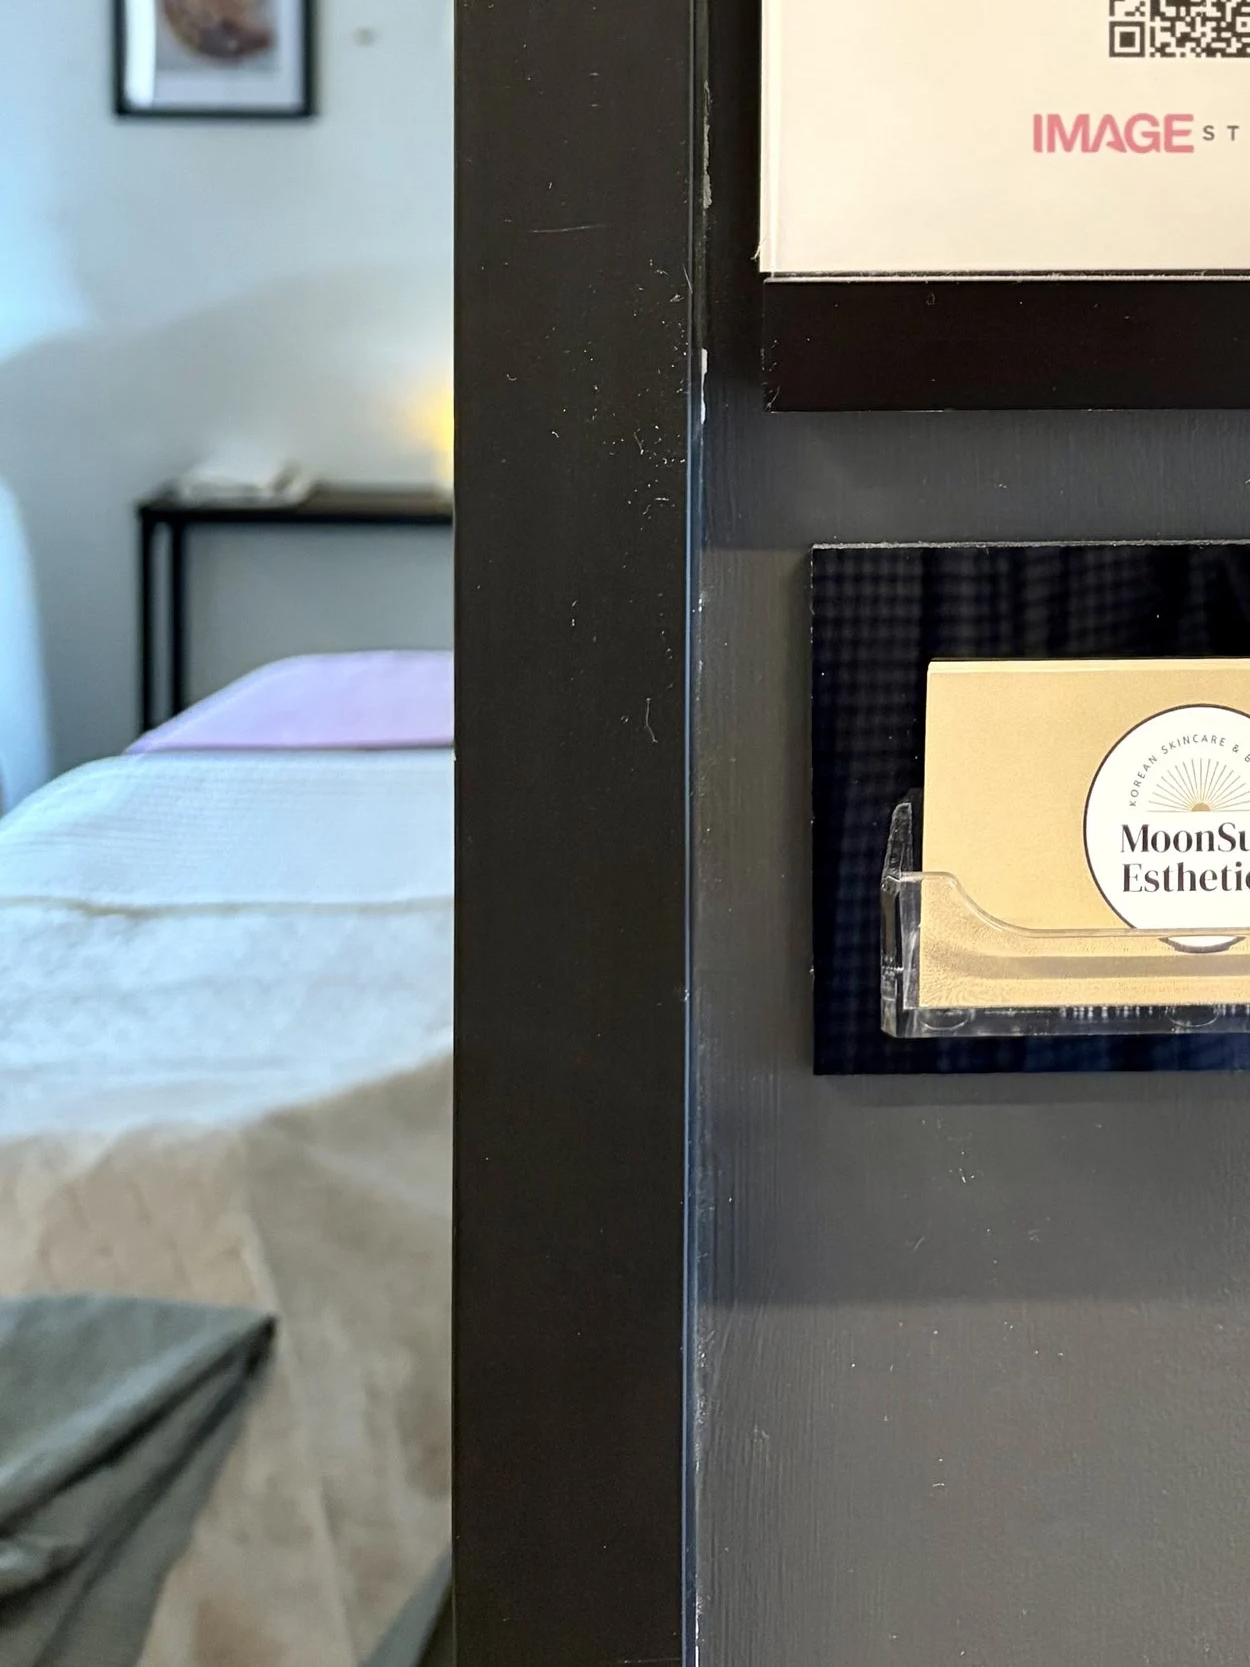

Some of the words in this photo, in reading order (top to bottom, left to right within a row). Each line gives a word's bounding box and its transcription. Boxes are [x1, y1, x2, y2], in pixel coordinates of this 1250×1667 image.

[1032, 112, 1195, 154] IMAGE
[1128, 755, 1158, 808] KOREAN
[1160, 733, 1227, 755] SKINCARE
[1231, 743, 1240, 754] &
